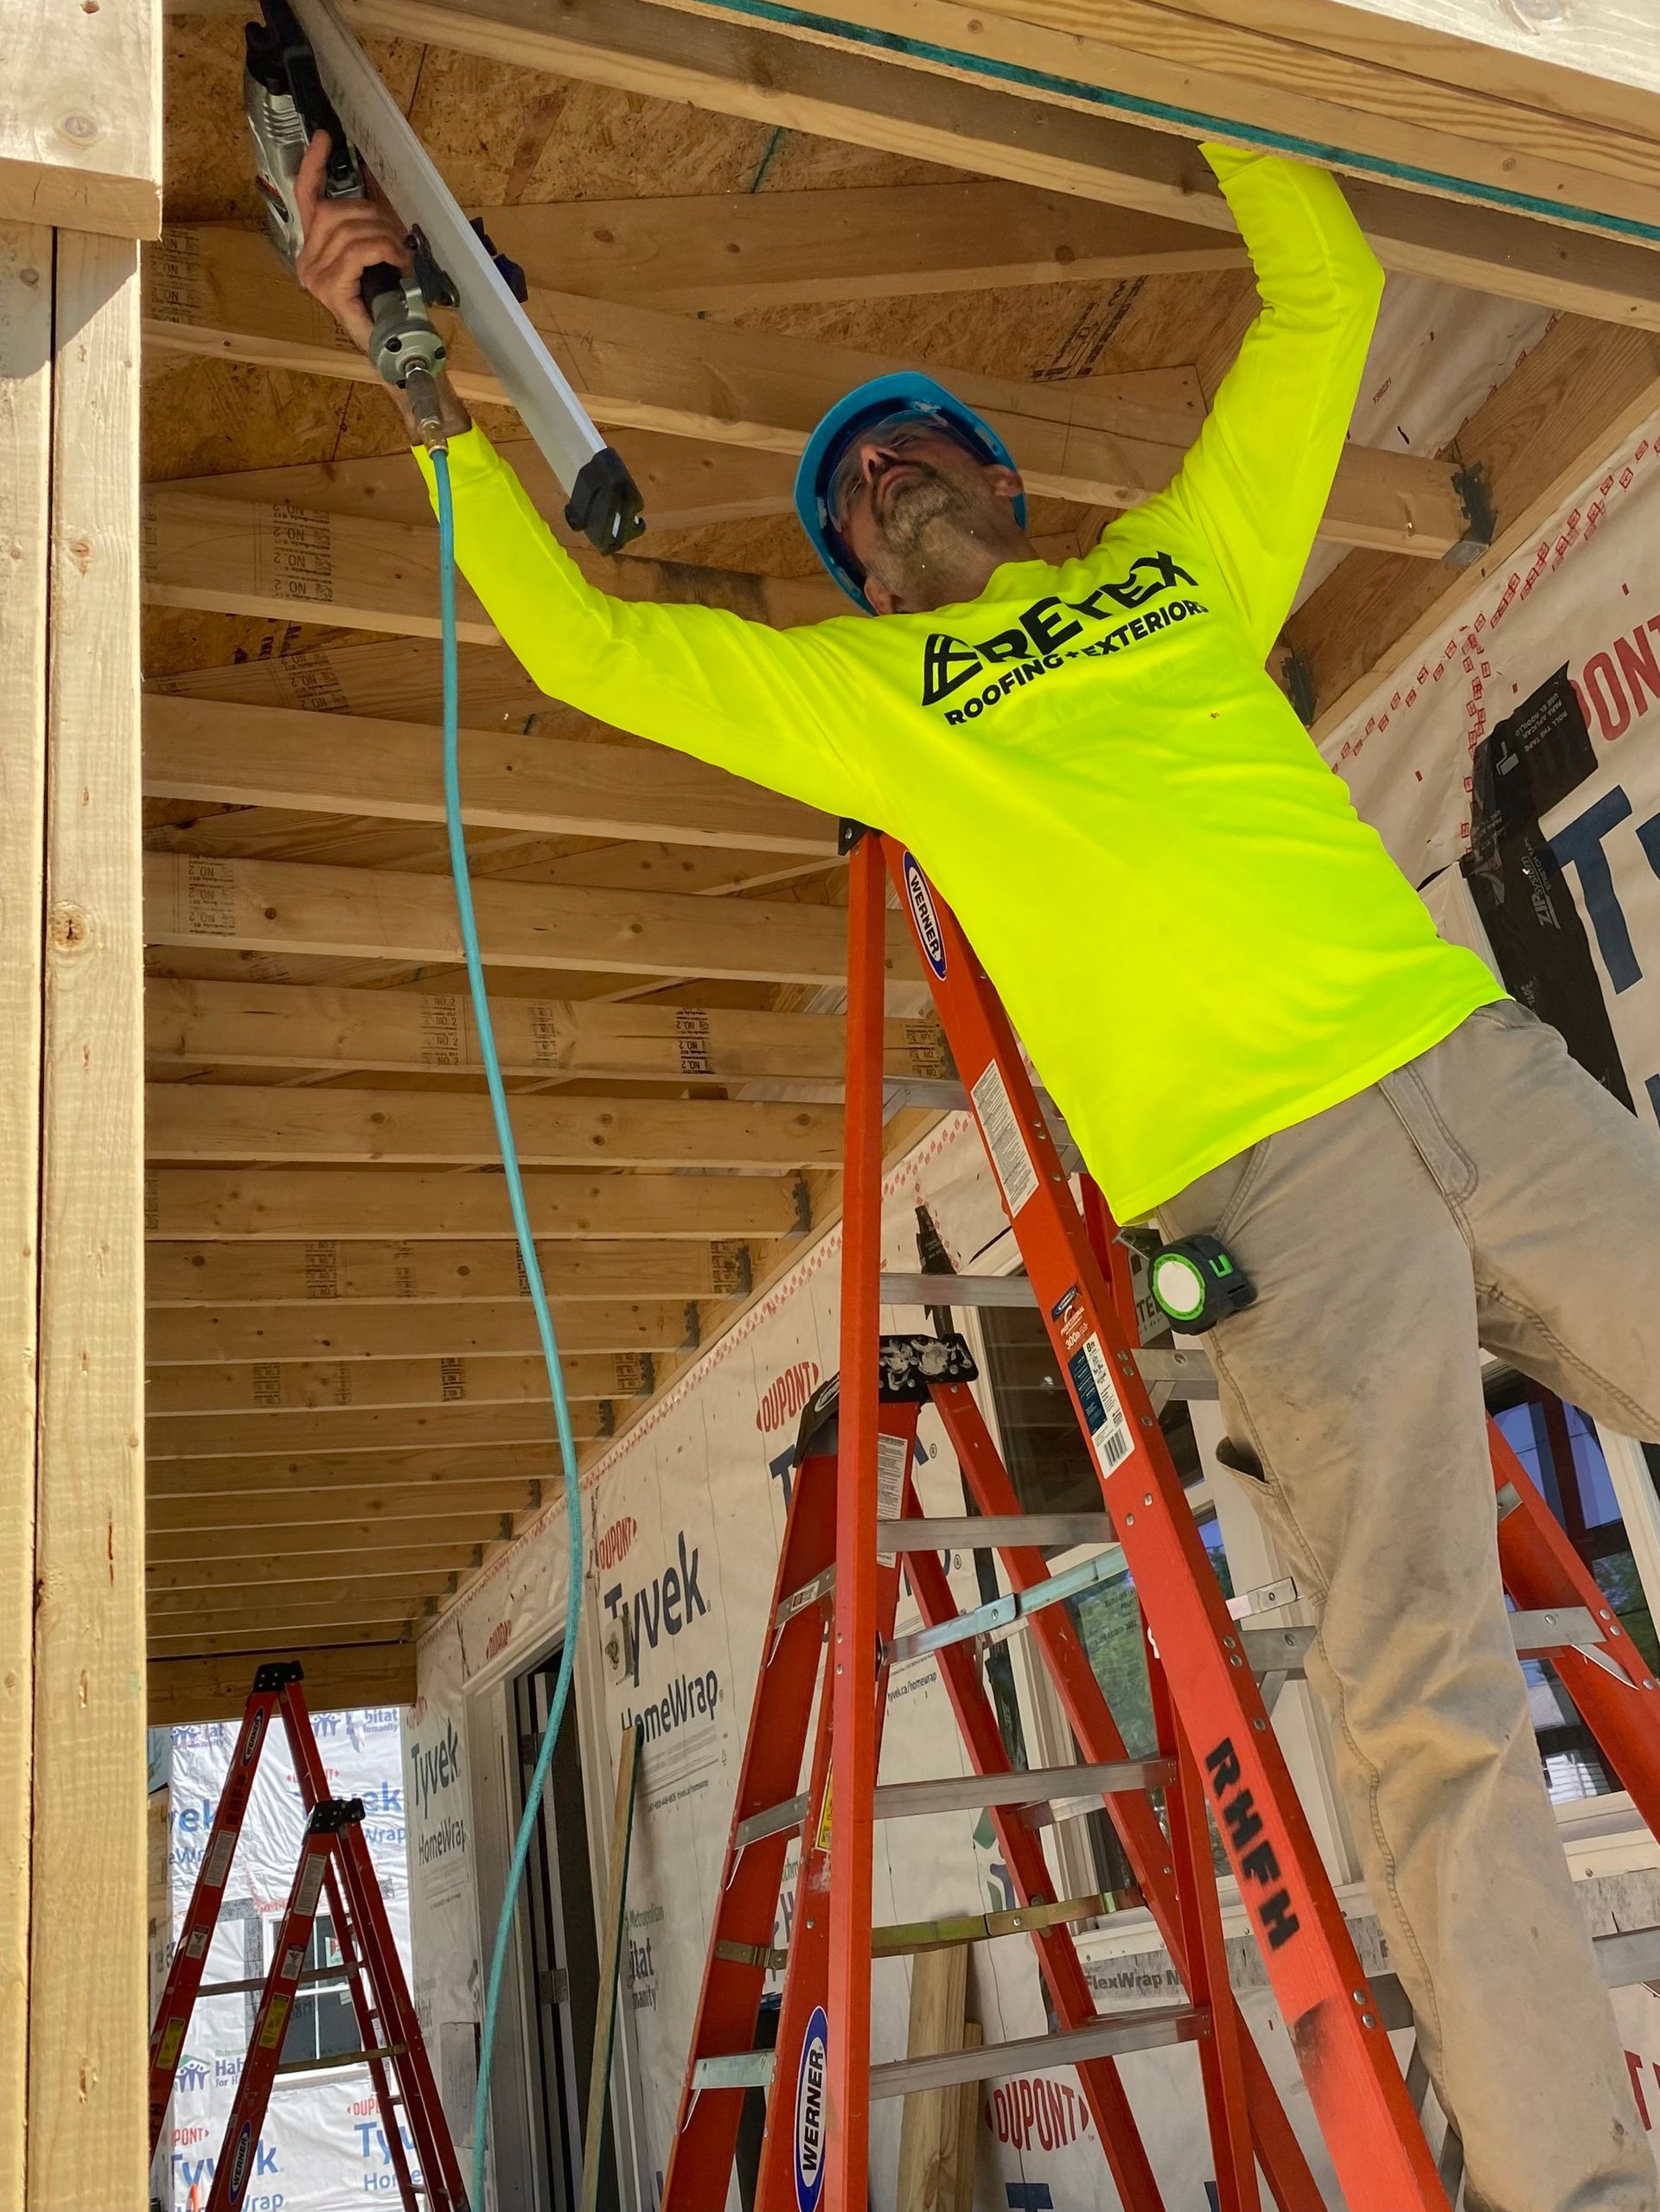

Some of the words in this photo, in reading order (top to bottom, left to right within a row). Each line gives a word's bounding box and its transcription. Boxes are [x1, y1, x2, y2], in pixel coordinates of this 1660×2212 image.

[1539, 725, 1552, 740] THE
[1547, 698, 1563, 716] PARA
[1553, 711, 1568, 727] ROLL
[1523, 736, 1541, 753] TAPE
[910, 874, 939, 954] WERNER
[762, 1361, 812, 1433] DUPONT
[598, 1516, 633, 1571] DUPONT
[604, 1530, 707, 1689] Tyvek
[888, 1671, 937, 1703] tyvek.ca/homewrap
[246, 1718, 261, 1756] WERNER
[411, 1716, 458, 1820] Tyvek
[1206, 1737, 1300, 1951] RHFH
[802, 2047, 823, 2171] WERNER
[993, 2077, 1077, 2151] DUPONT
[173, 2127, 203, 2147] PONT
[233, 2136, 249, 2187] WERNER
